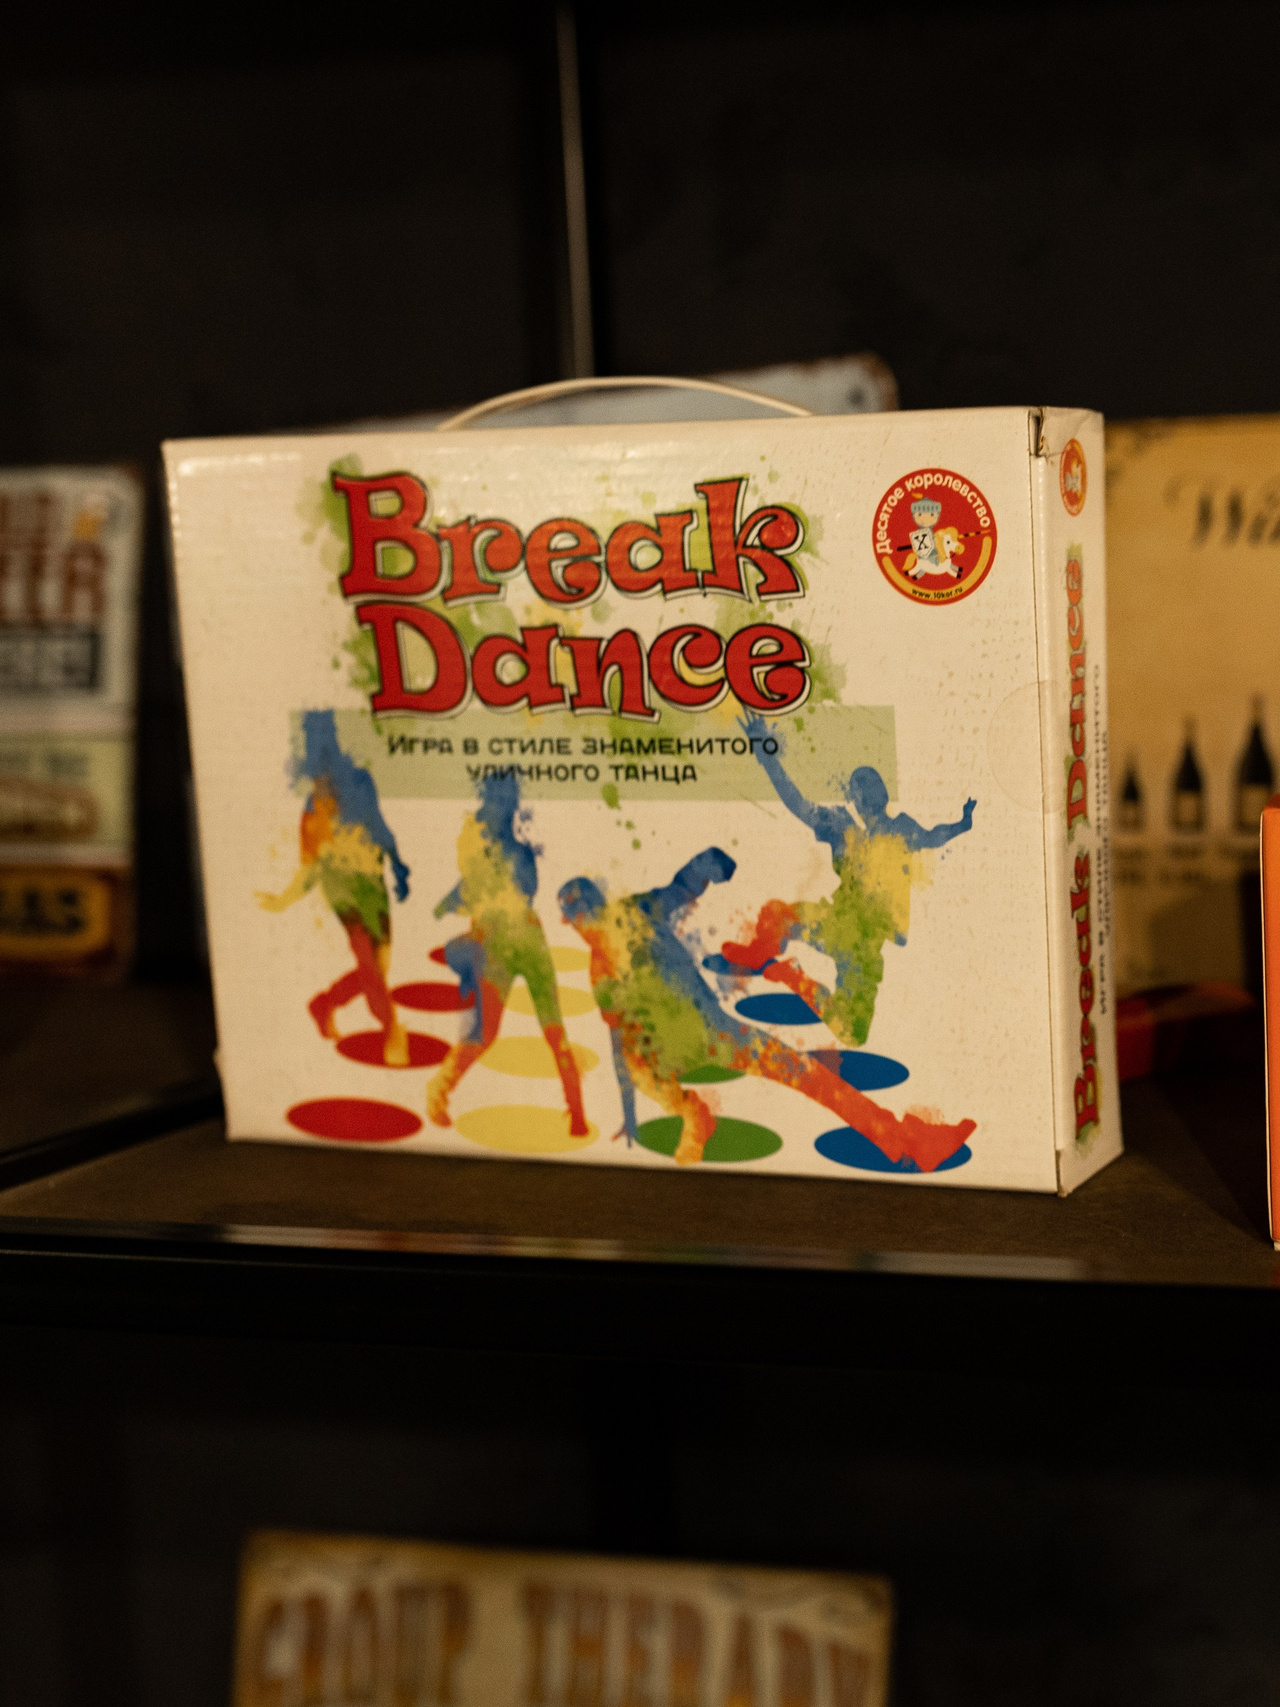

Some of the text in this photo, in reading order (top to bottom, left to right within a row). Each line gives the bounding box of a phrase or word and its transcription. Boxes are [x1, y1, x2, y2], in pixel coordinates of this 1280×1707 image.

[331, 471, 806, 609] Break
[875, 486, 905, 555] Десятое
[905, 473, 991, 528] королевство
[355, 601, 811, 723] Dance
[1065, 558, 1099, 1140] Break Dance
